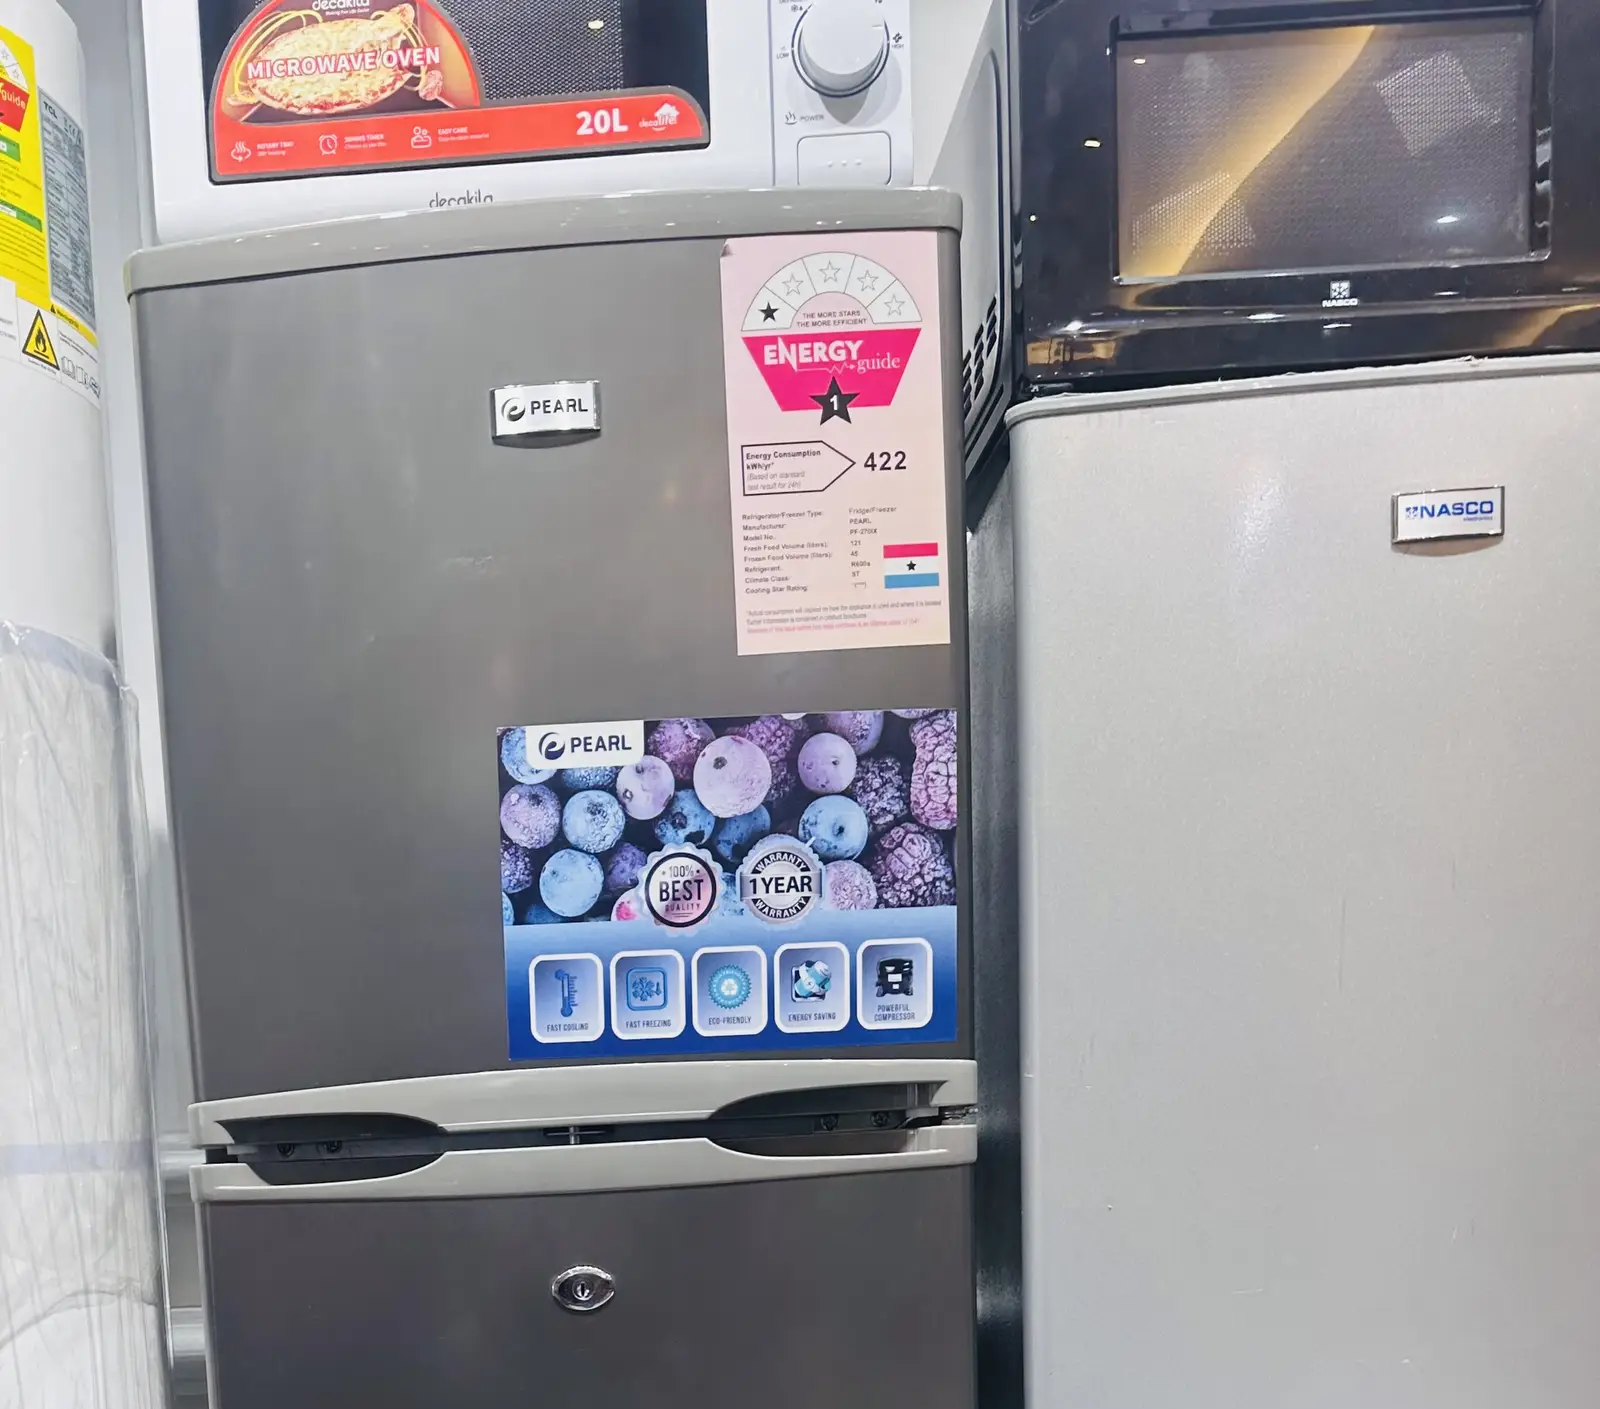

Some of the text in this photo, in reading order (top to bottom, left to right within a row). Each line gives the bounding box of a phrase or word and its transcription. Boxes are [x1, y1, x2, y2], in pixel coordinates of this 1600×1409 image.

[247, 47, 440, 80] MICROWAVE OVEN
[43, 101, 58, 119] TCL
[800, 114, 824, 122] POWER
[576, 108, 629, 135] 20L
[1322, 298, 1358, 308] NASCO
[833, 318, 867, 326] EFFICIENT
[764, 336, 864, 372] ENERGY
[857, 352, 900, 374] guide
[531, 398, 588, 415] PEARL
[830, 395, 839, 411] 1
[746, 449, 821, 461] Energy Consumption
[863, 451, 907, 471] 422
[1420, 500, 1493, 518] NASCO
[570, 734, 632, 754] PEARL
[755, 852, 807, 872] WARRANTY
[669, 864, 694, 878] 100%
[659, 879, 704, 902] BEST
[665, 903, 701, 912] QUALITY
[755, 897, 806, 919] WARRANTY
[877, 1004, 910, 1012] POWERFUL
[626, 1019, 672, 1029] FAST FREEZING
[708, 1016, 751, 1025] ECO-FRIENDLY
[788, 1012, 836, 1022] ENERGY SAVING
[874, 1012, 915, 1022] COMPRESSOR
[547, 1023, 588, 1032] FAST COOLING
